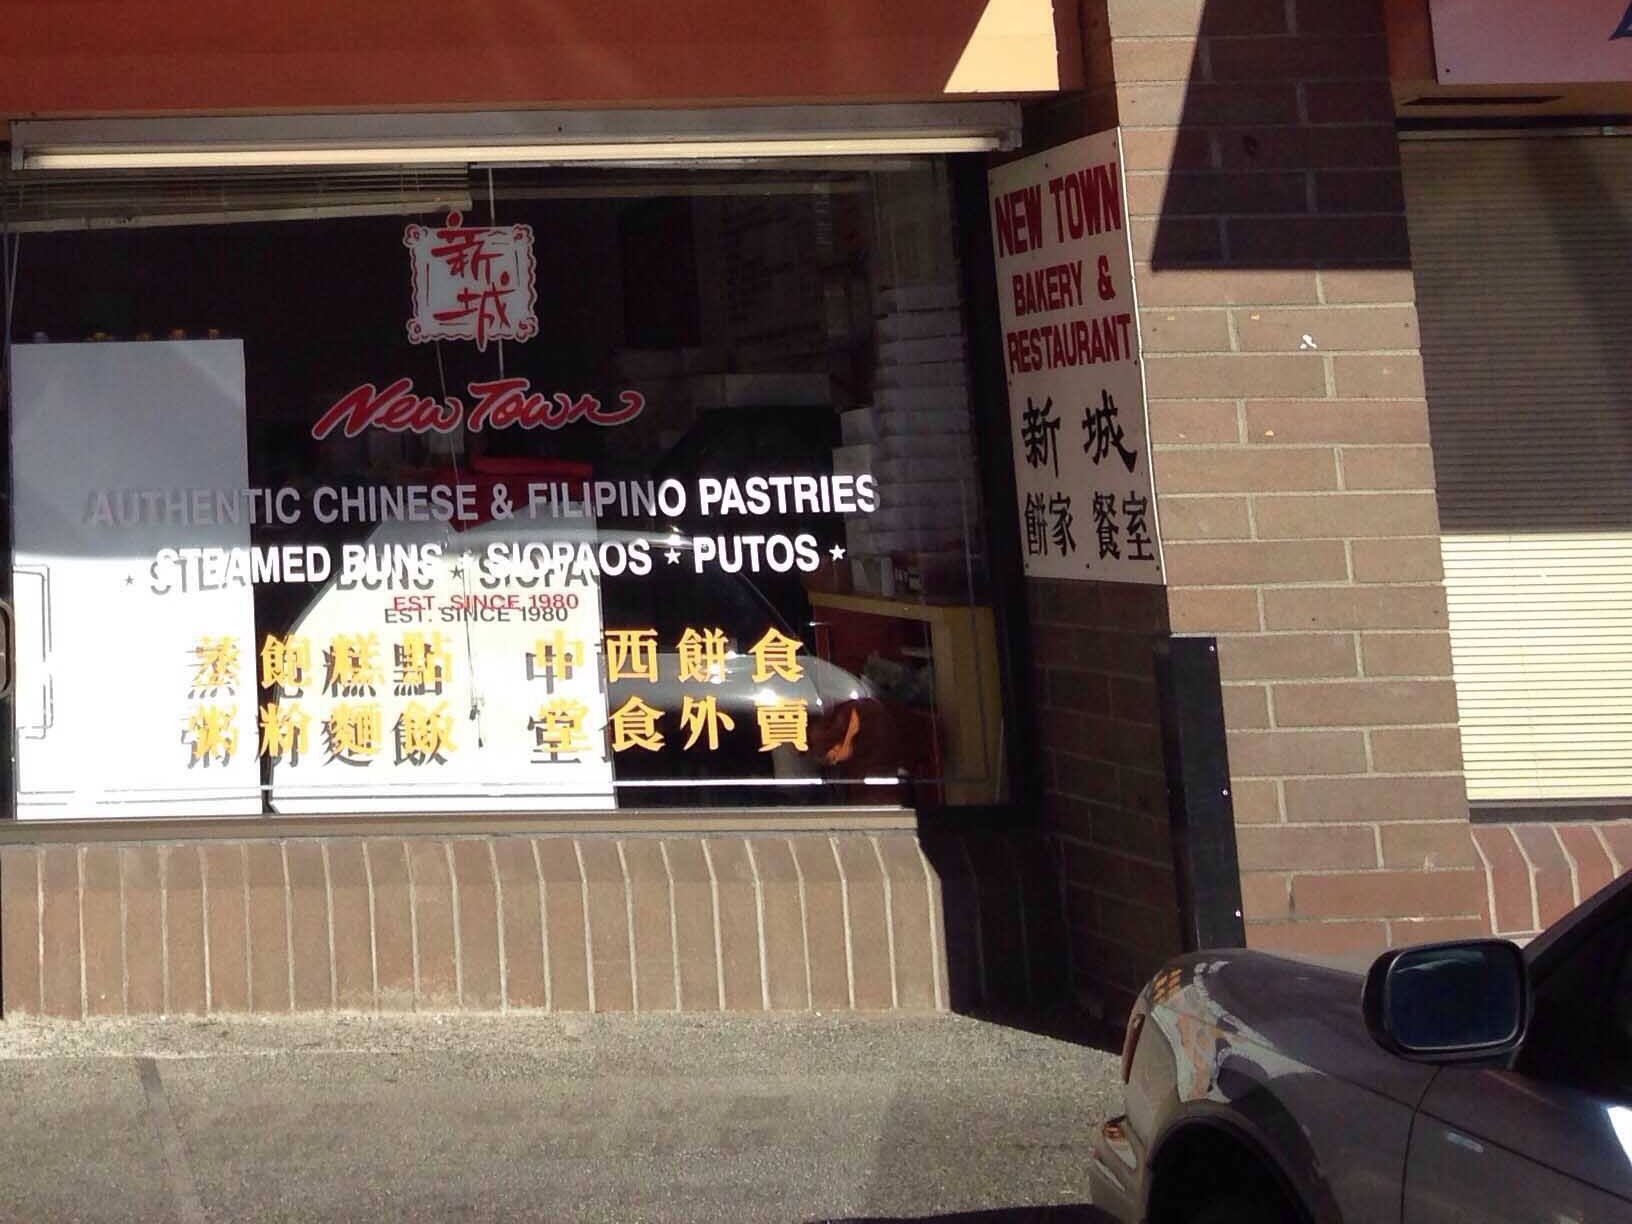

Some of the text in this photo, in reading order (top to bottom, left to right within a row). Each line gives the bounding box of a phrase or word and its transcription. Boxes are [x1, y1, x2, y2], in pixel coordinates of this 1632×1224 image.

[995, 162, 1122, 258] NEW TOWN
[1012, 255, 1116, 317] BAKERY &
[1007, 314, 1132, 374] RESTAURANT
[312, 378, 645, 440] New Town
[92, 475, 879, 527] AUTHENTIC CHINESE & FILIPINO PASTRIES
[155, 534, 820, 585] STEAMED BUNS SIOPAOS PUTOS
[450, 594, 520, 611] SINCE
[530, 593, 579, 610] 1980
[534, 628, 804, 683] 中西餅食
